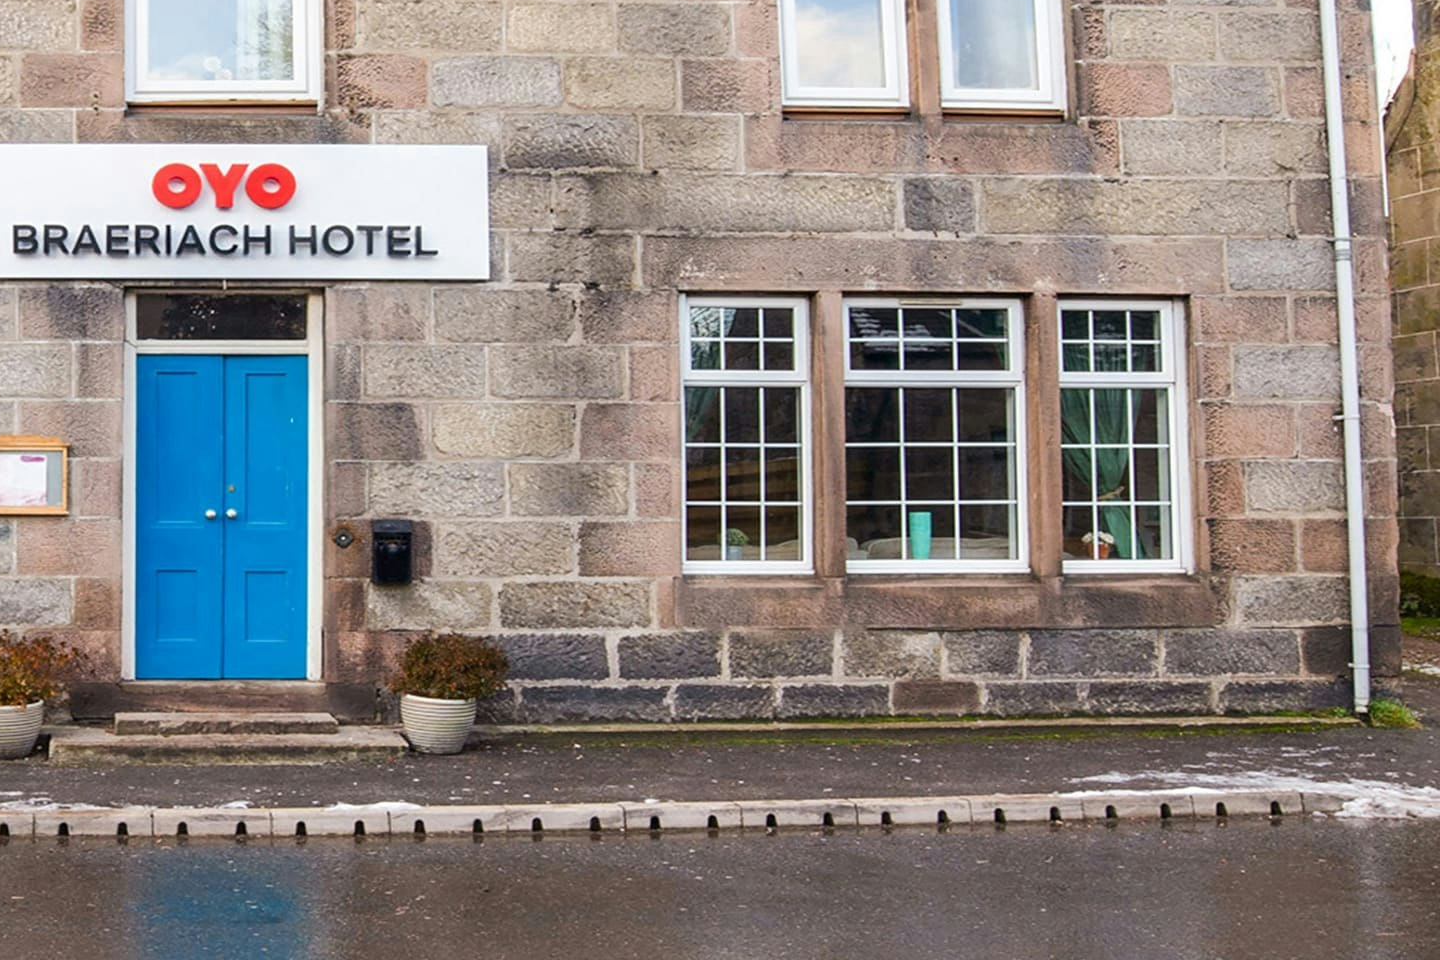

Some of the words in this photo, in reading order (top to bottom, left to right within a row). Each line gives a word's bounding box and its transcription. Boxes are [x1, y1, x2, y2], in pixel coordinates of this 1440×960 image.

[152, 163, 296, 209] OYO
[12, 224, 271, 256] BRAERIACH
[288, 224, 438, 257] HOTEL
